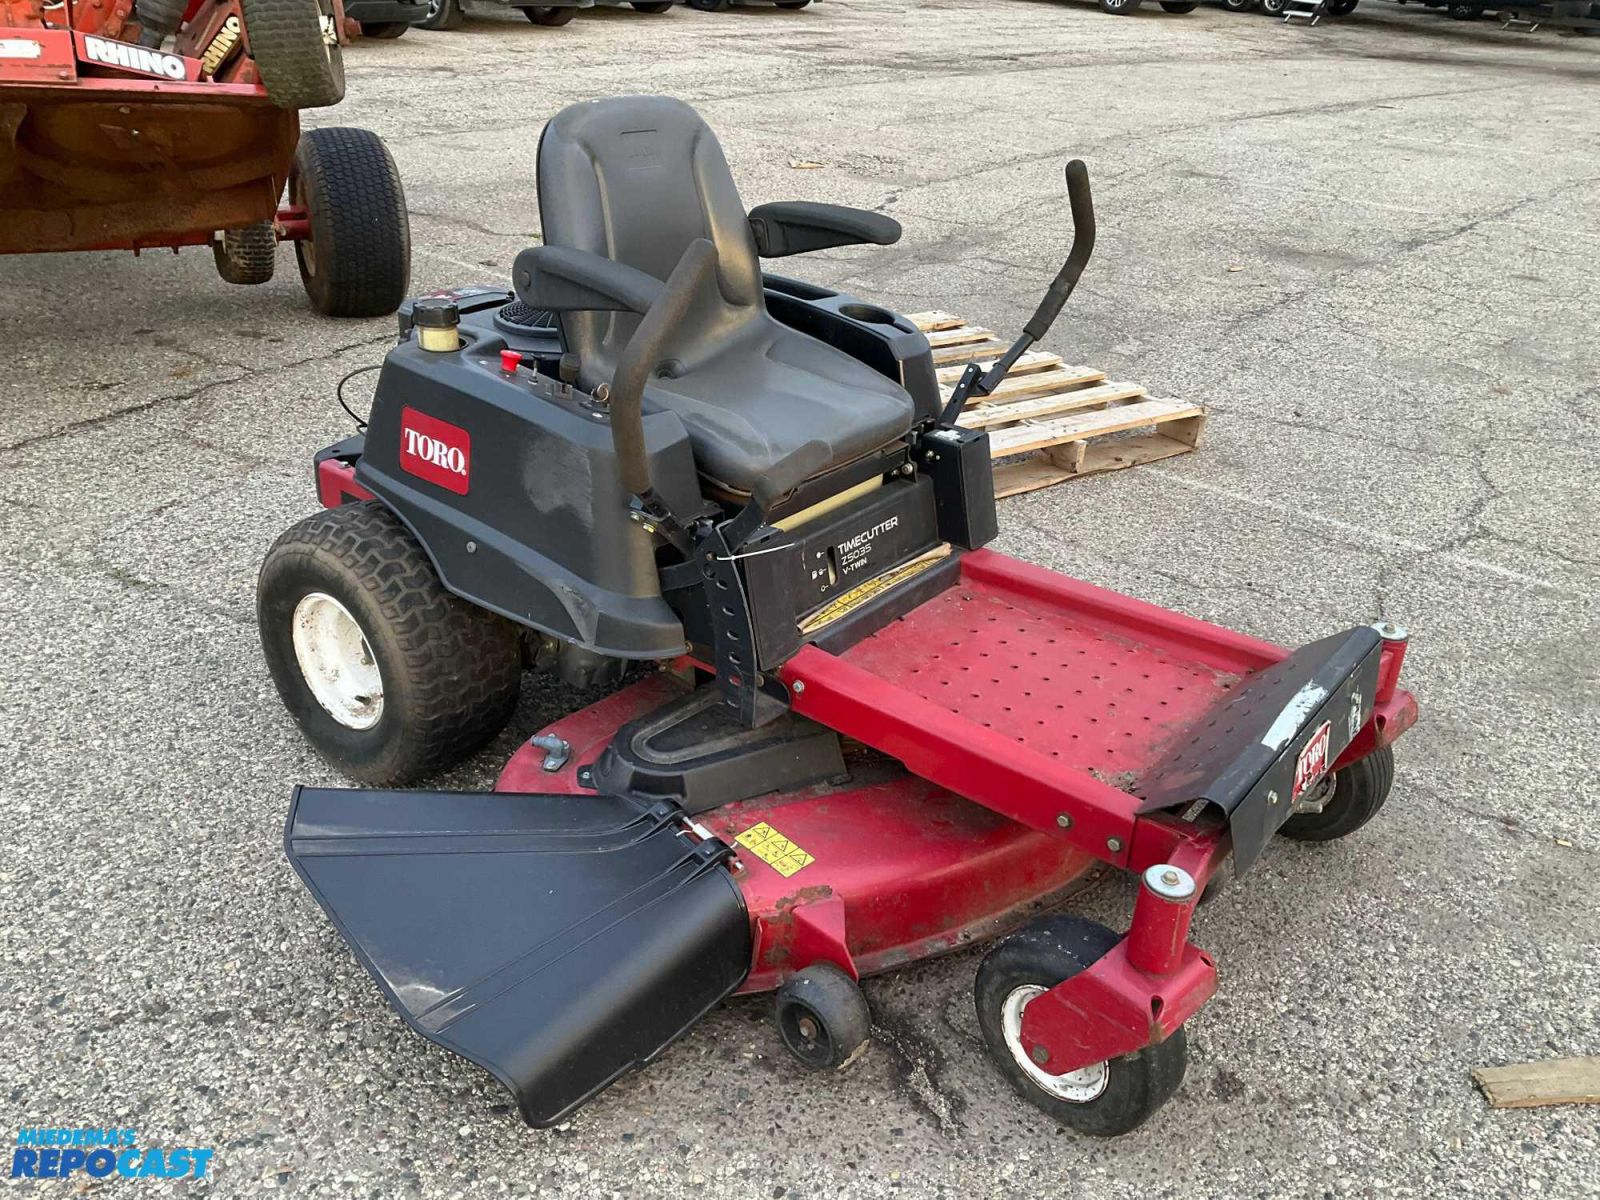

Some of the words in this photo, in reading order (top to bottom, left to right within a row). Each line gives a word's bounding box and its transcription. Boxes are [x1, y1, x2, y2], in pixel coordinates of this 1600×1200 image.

[84, 35, 186, 80] RHINO
[202, 16, 241, 74] RHINO
[404, 427, 465, 474] TORO
[837, 515, 899, 555] TIMECUTTER
[841, 543, 872, 566] Z5035
[842, 557, 868, 575] V-TWIN
